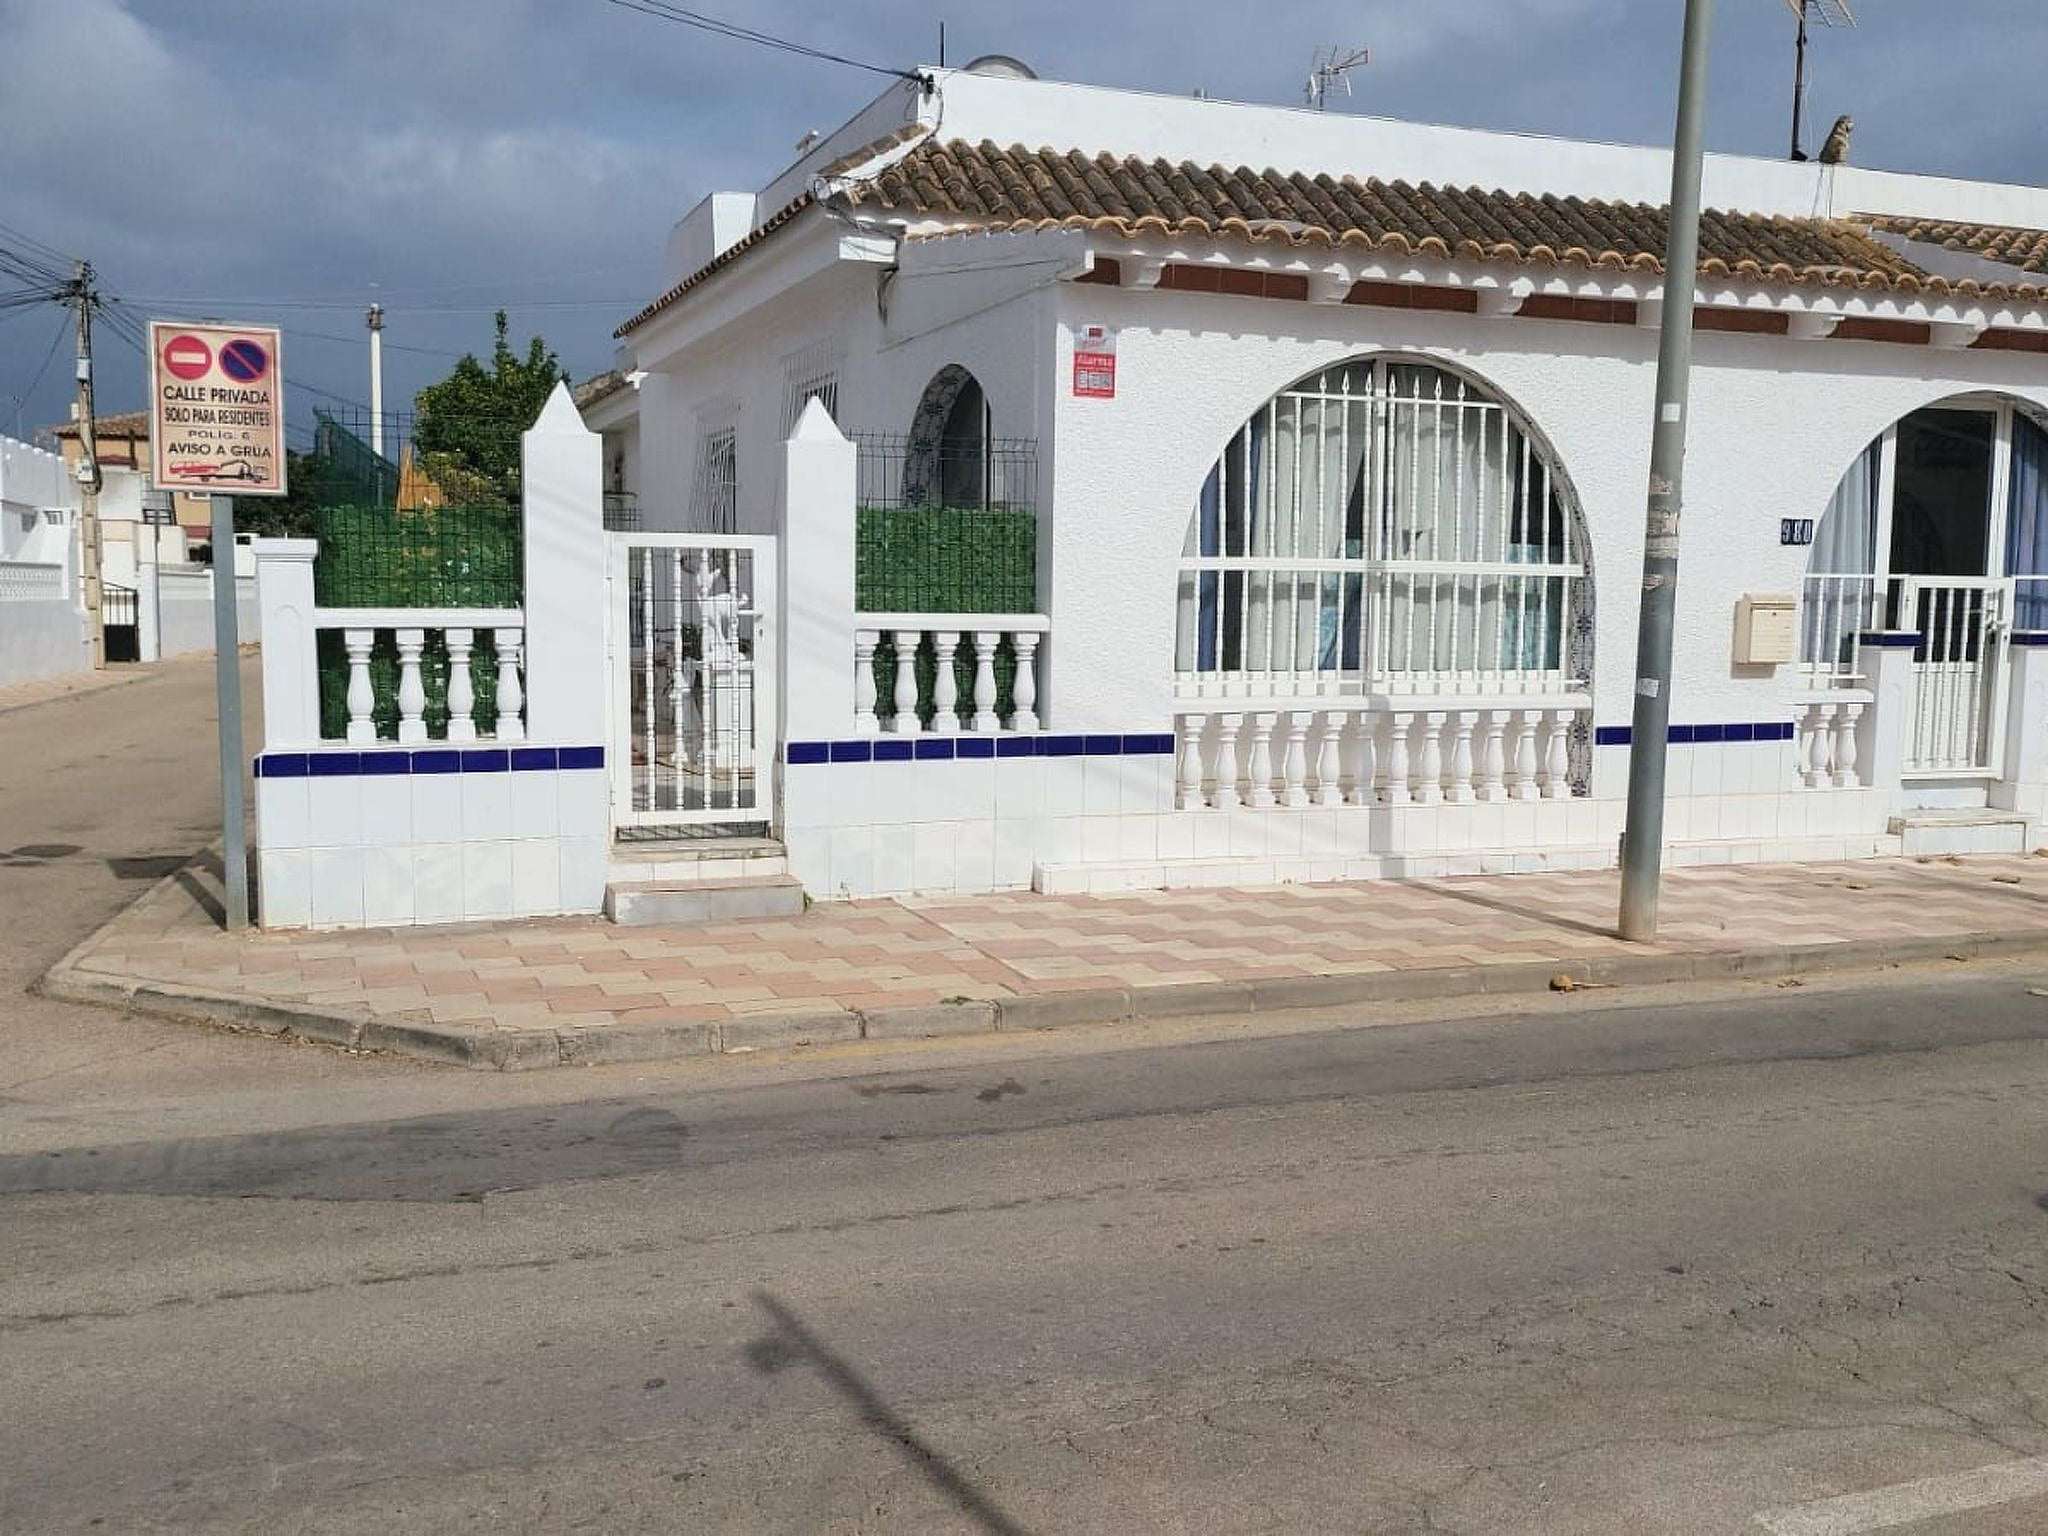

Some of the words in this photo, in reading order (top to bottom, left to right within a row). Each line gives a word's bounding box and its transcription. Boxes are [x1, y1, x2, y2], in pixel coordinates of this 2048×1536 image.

[164, 385, 206, 402] CALLE
[211, 388, 269, 404] PRIVADA
[165, 407, 190, 422] SOLO
[193, 408, 216, 424] PARA
[218, 409, 270, 426] RESIDENTES
[168, 442, 211, 455] AVISO
[216, 444, 227, 455] A
